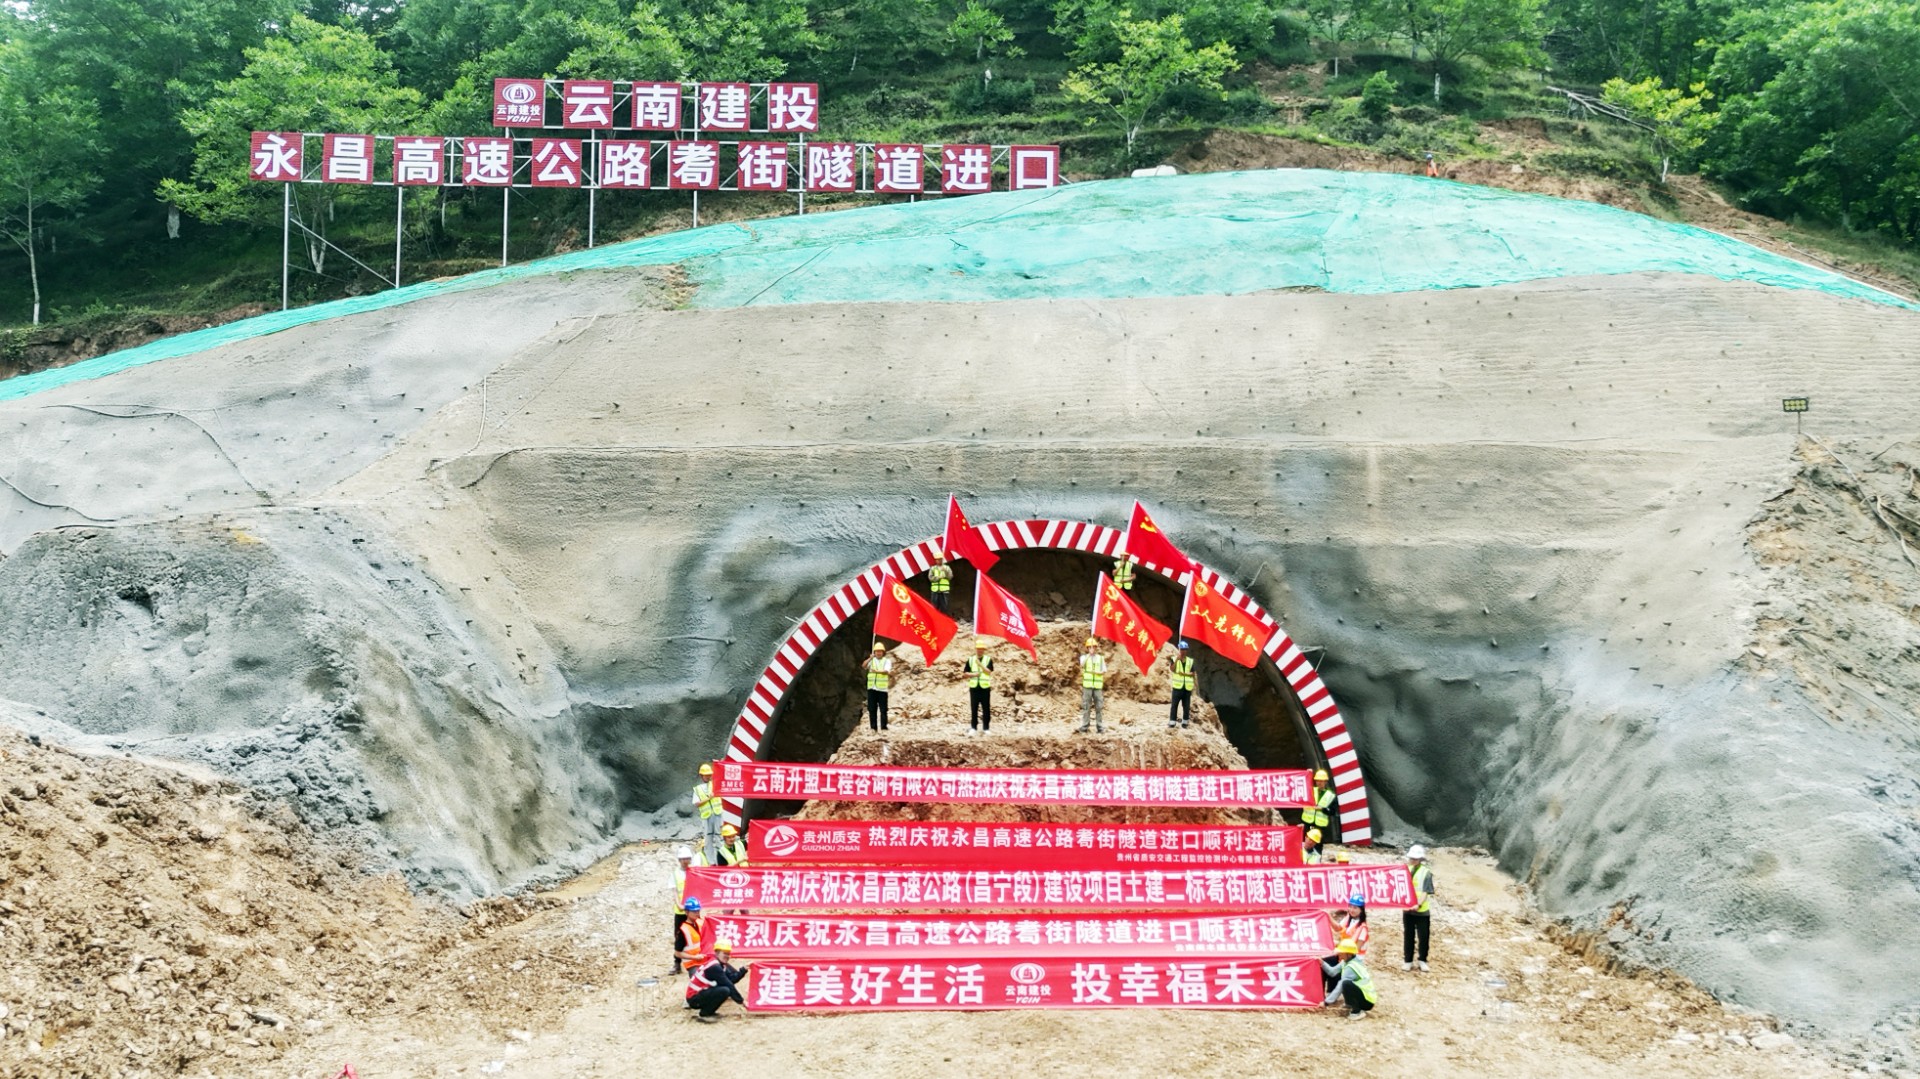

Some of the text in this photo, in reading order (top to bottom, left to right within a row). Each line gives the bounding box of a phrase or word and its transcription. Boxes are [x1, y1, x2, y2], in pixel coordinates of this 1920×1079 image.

[496, 104, 540, 116] 云南建投
[566, 84, 817, 131] 云南建投
[1190, 605, 1259, 652] 工人先锋队
[802, 830, 861, 844] 贵州质安
[712, 888, 754, 898] 云南建投
[756, 963, 985, 1006] 建美好生活
[1005, 984, 1051, 996] 云南建投
[1070, 962, 1304, 1004] 投幸福未来
